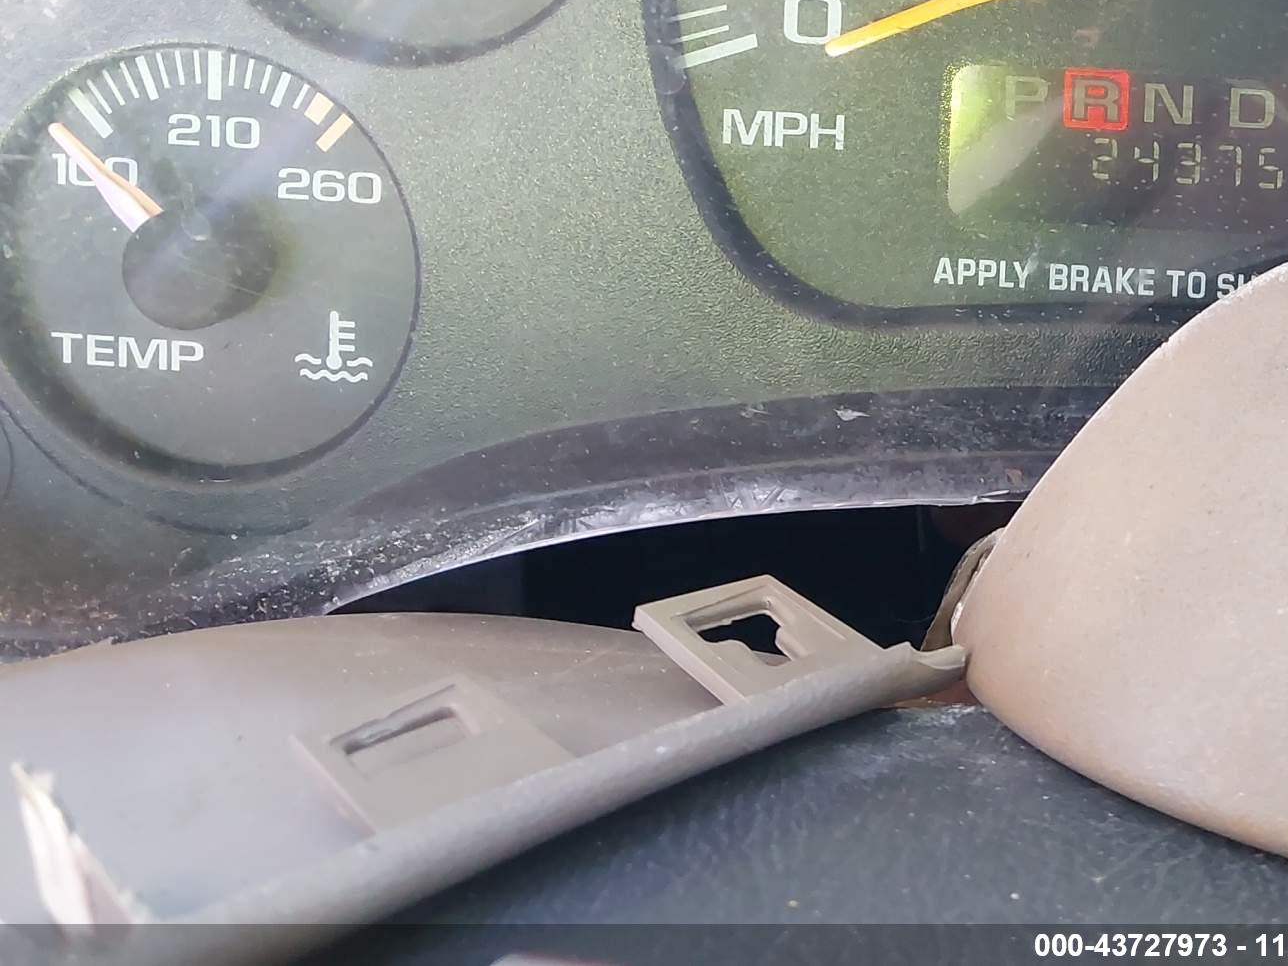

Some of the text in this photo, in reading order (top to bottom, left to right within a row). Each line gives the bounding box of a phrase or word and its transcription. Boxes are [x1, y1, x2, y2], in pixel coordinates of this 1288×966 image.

[167, 113, 260, 149] 210
[722, 108, 846, 151] MPH
[277, 167, 382, 204] 260
[933, 256, 1029, 290] APPLY
[1048, 262, 1156, 297] BRAKE
[1166, 269, 1206, 299] TO
[51, 332, 204, 372] TEMP
